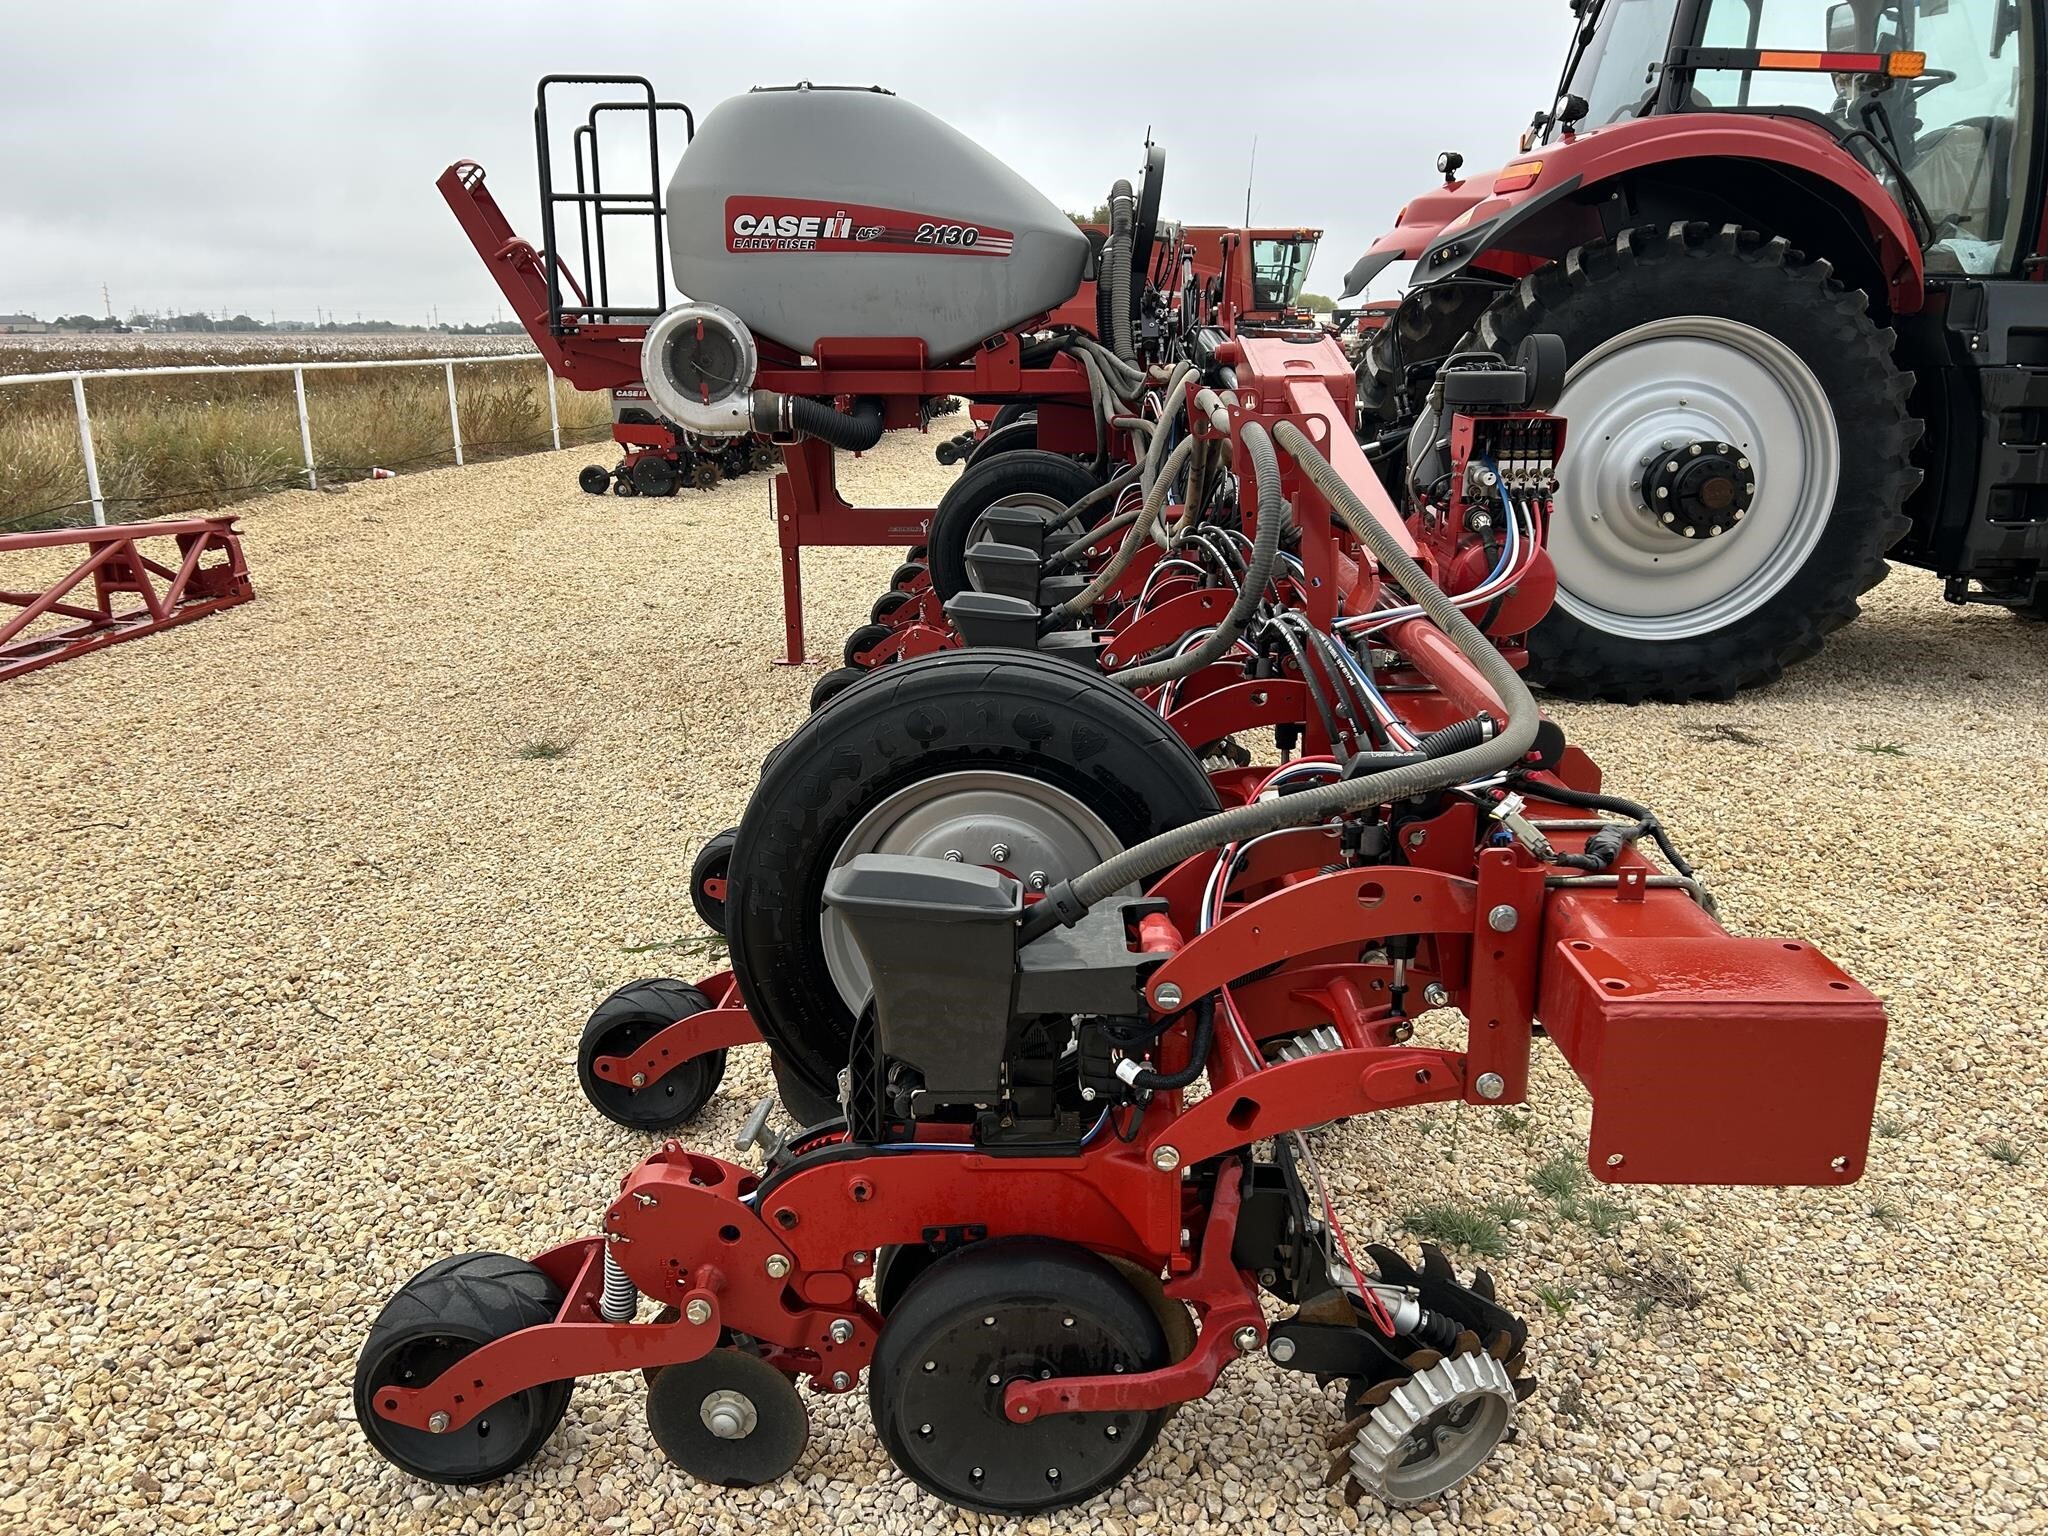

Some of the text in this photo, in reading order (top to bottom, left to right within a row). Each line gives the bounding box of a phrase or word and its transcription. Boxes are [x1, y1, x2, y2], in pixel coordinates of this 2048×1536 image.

[733, 214, 821, 238] CASE
[856, 226, 881, 241] AFS
[914, 223, 979, 247] 2130
[733, 238, 816, 250] EARLY RISER
